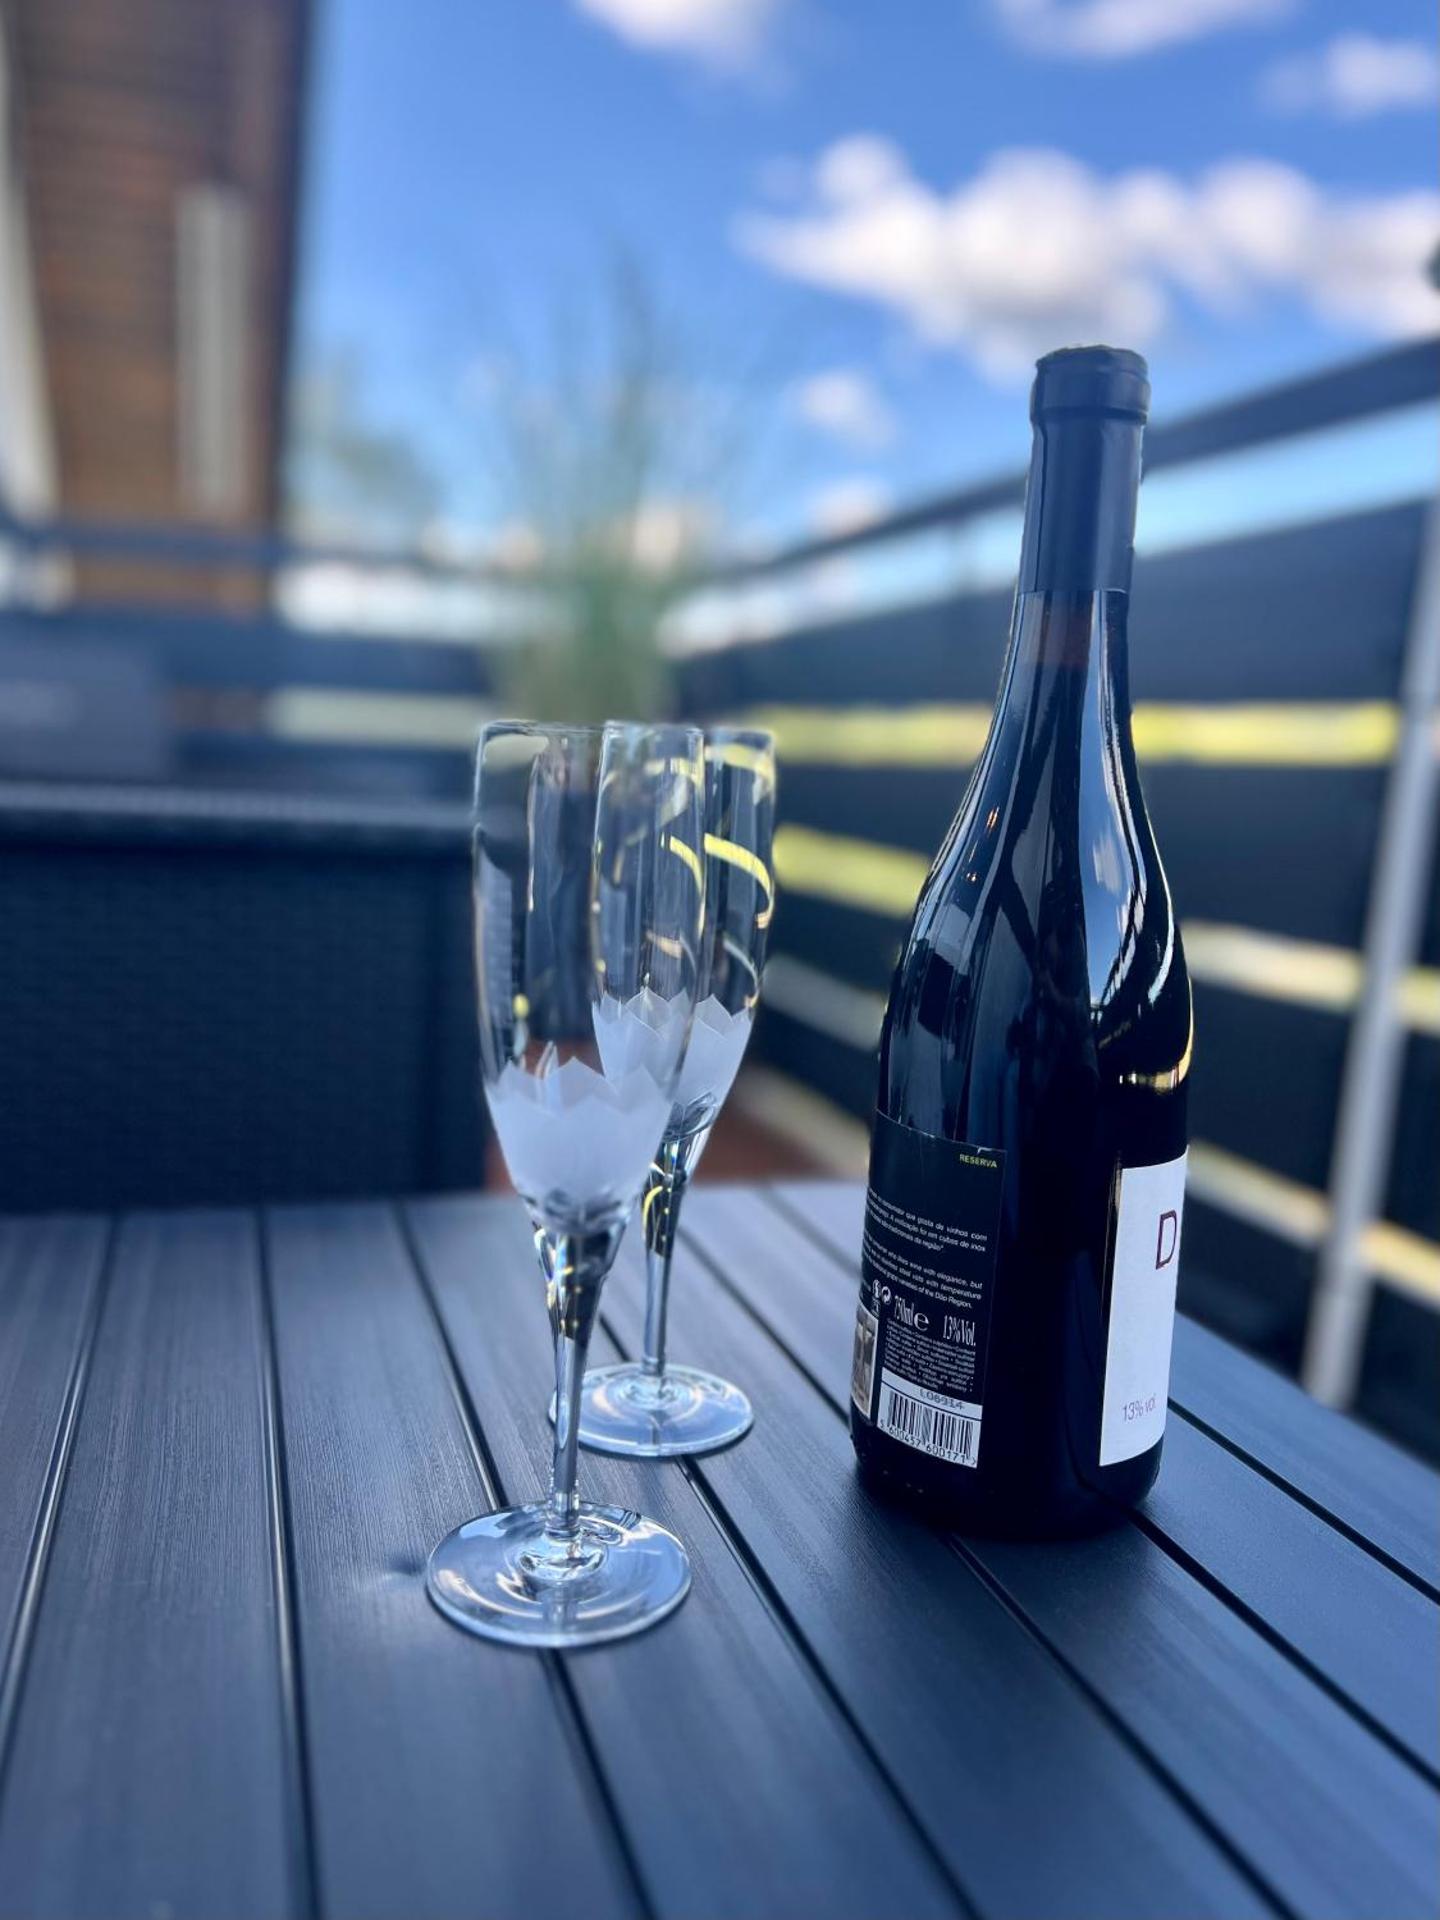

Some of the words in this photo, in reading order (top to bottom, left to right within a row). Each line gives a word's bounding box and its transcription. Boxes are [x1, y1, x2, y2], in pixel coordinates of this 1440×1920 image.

[959, 1153, 998, 1168] RESERVA
[946, 1225, 968, 1238] vinhos
[970, 1233, 987, 1242] com
[1155, 1210, 1177, 1270] D
[959, 1240, 969, 1249] de
[940, 1283, 982, 1300] temperature
[969, 1279, 983, 1290] but
